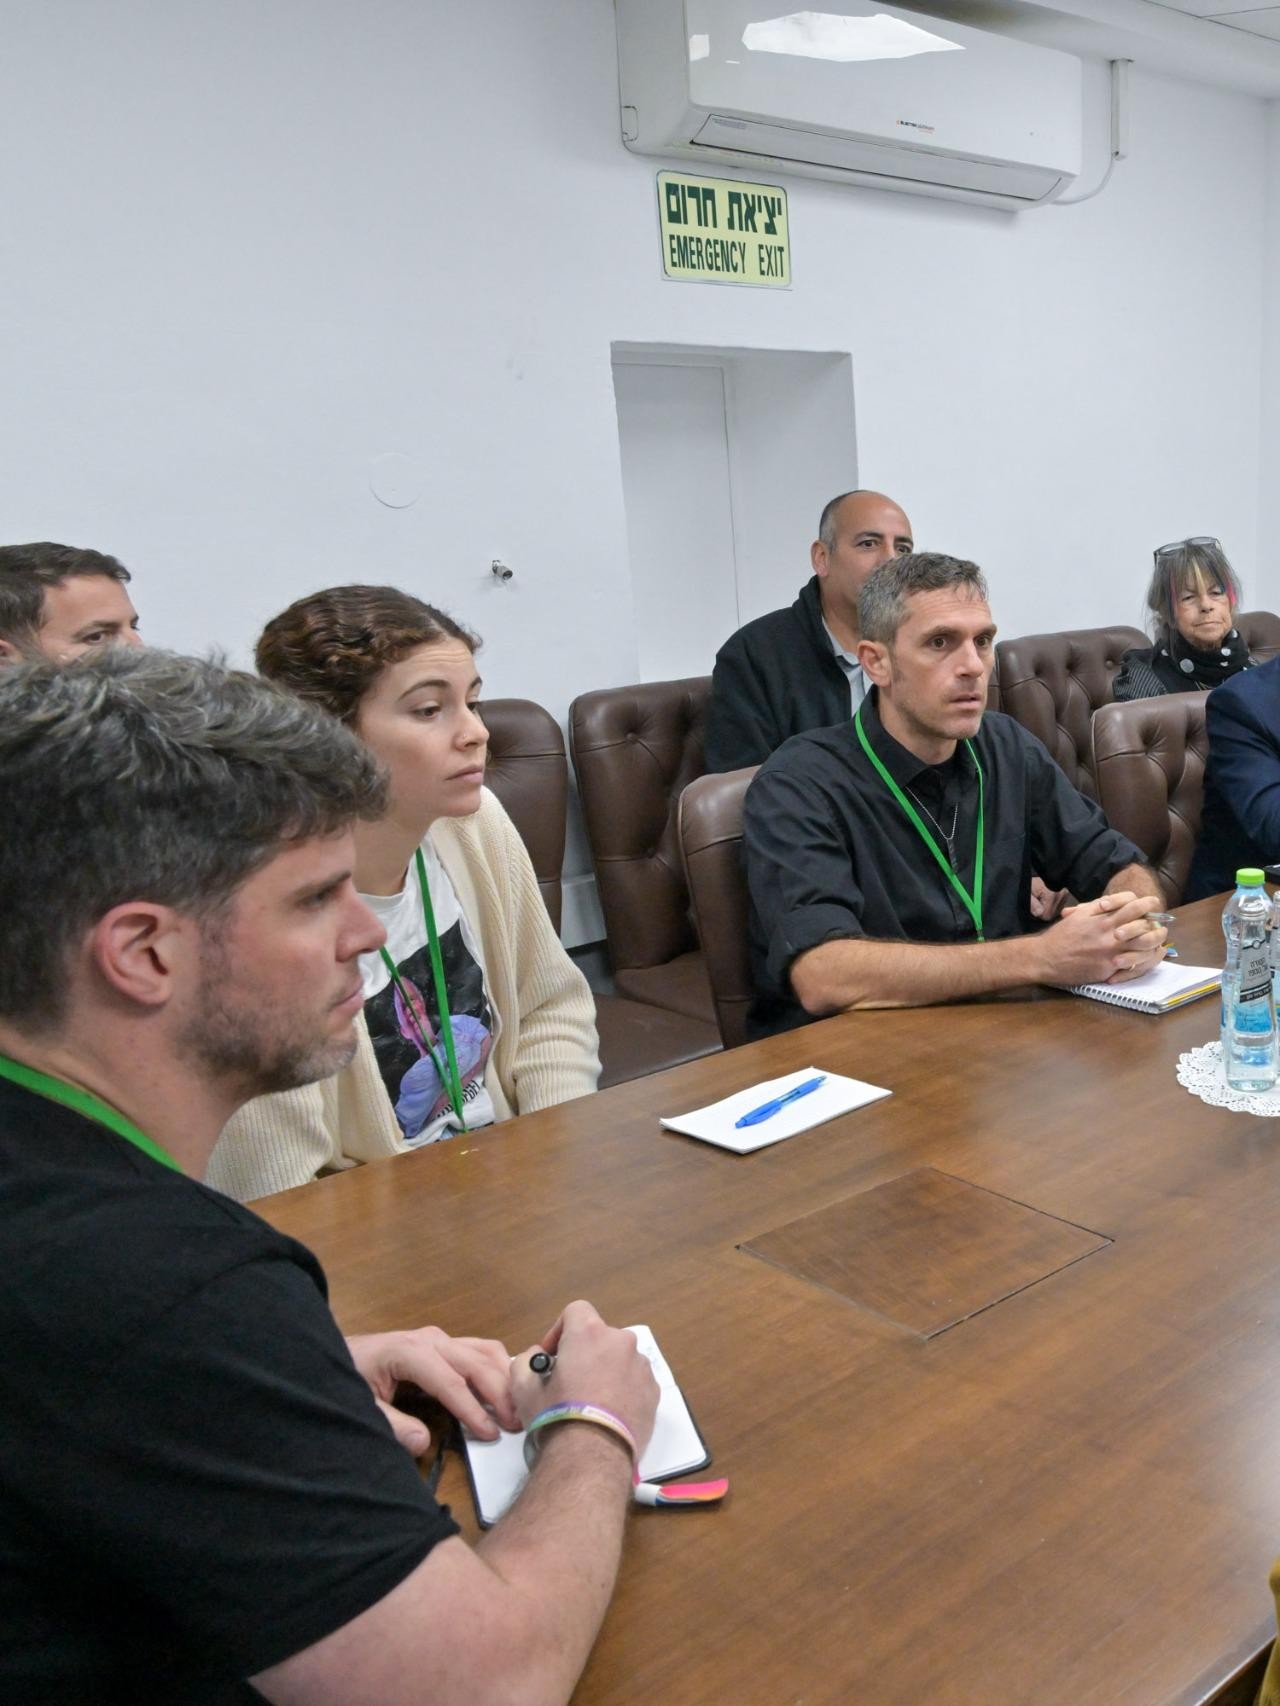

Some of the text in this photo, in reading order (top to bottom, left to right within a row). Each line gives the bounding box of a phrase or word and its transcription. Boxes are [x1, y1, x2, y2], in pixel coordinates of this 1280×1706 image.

[665, 182, 783, 236] יציאת חרום
[668, 234, 785, 278] EMERGENCY EXIT
